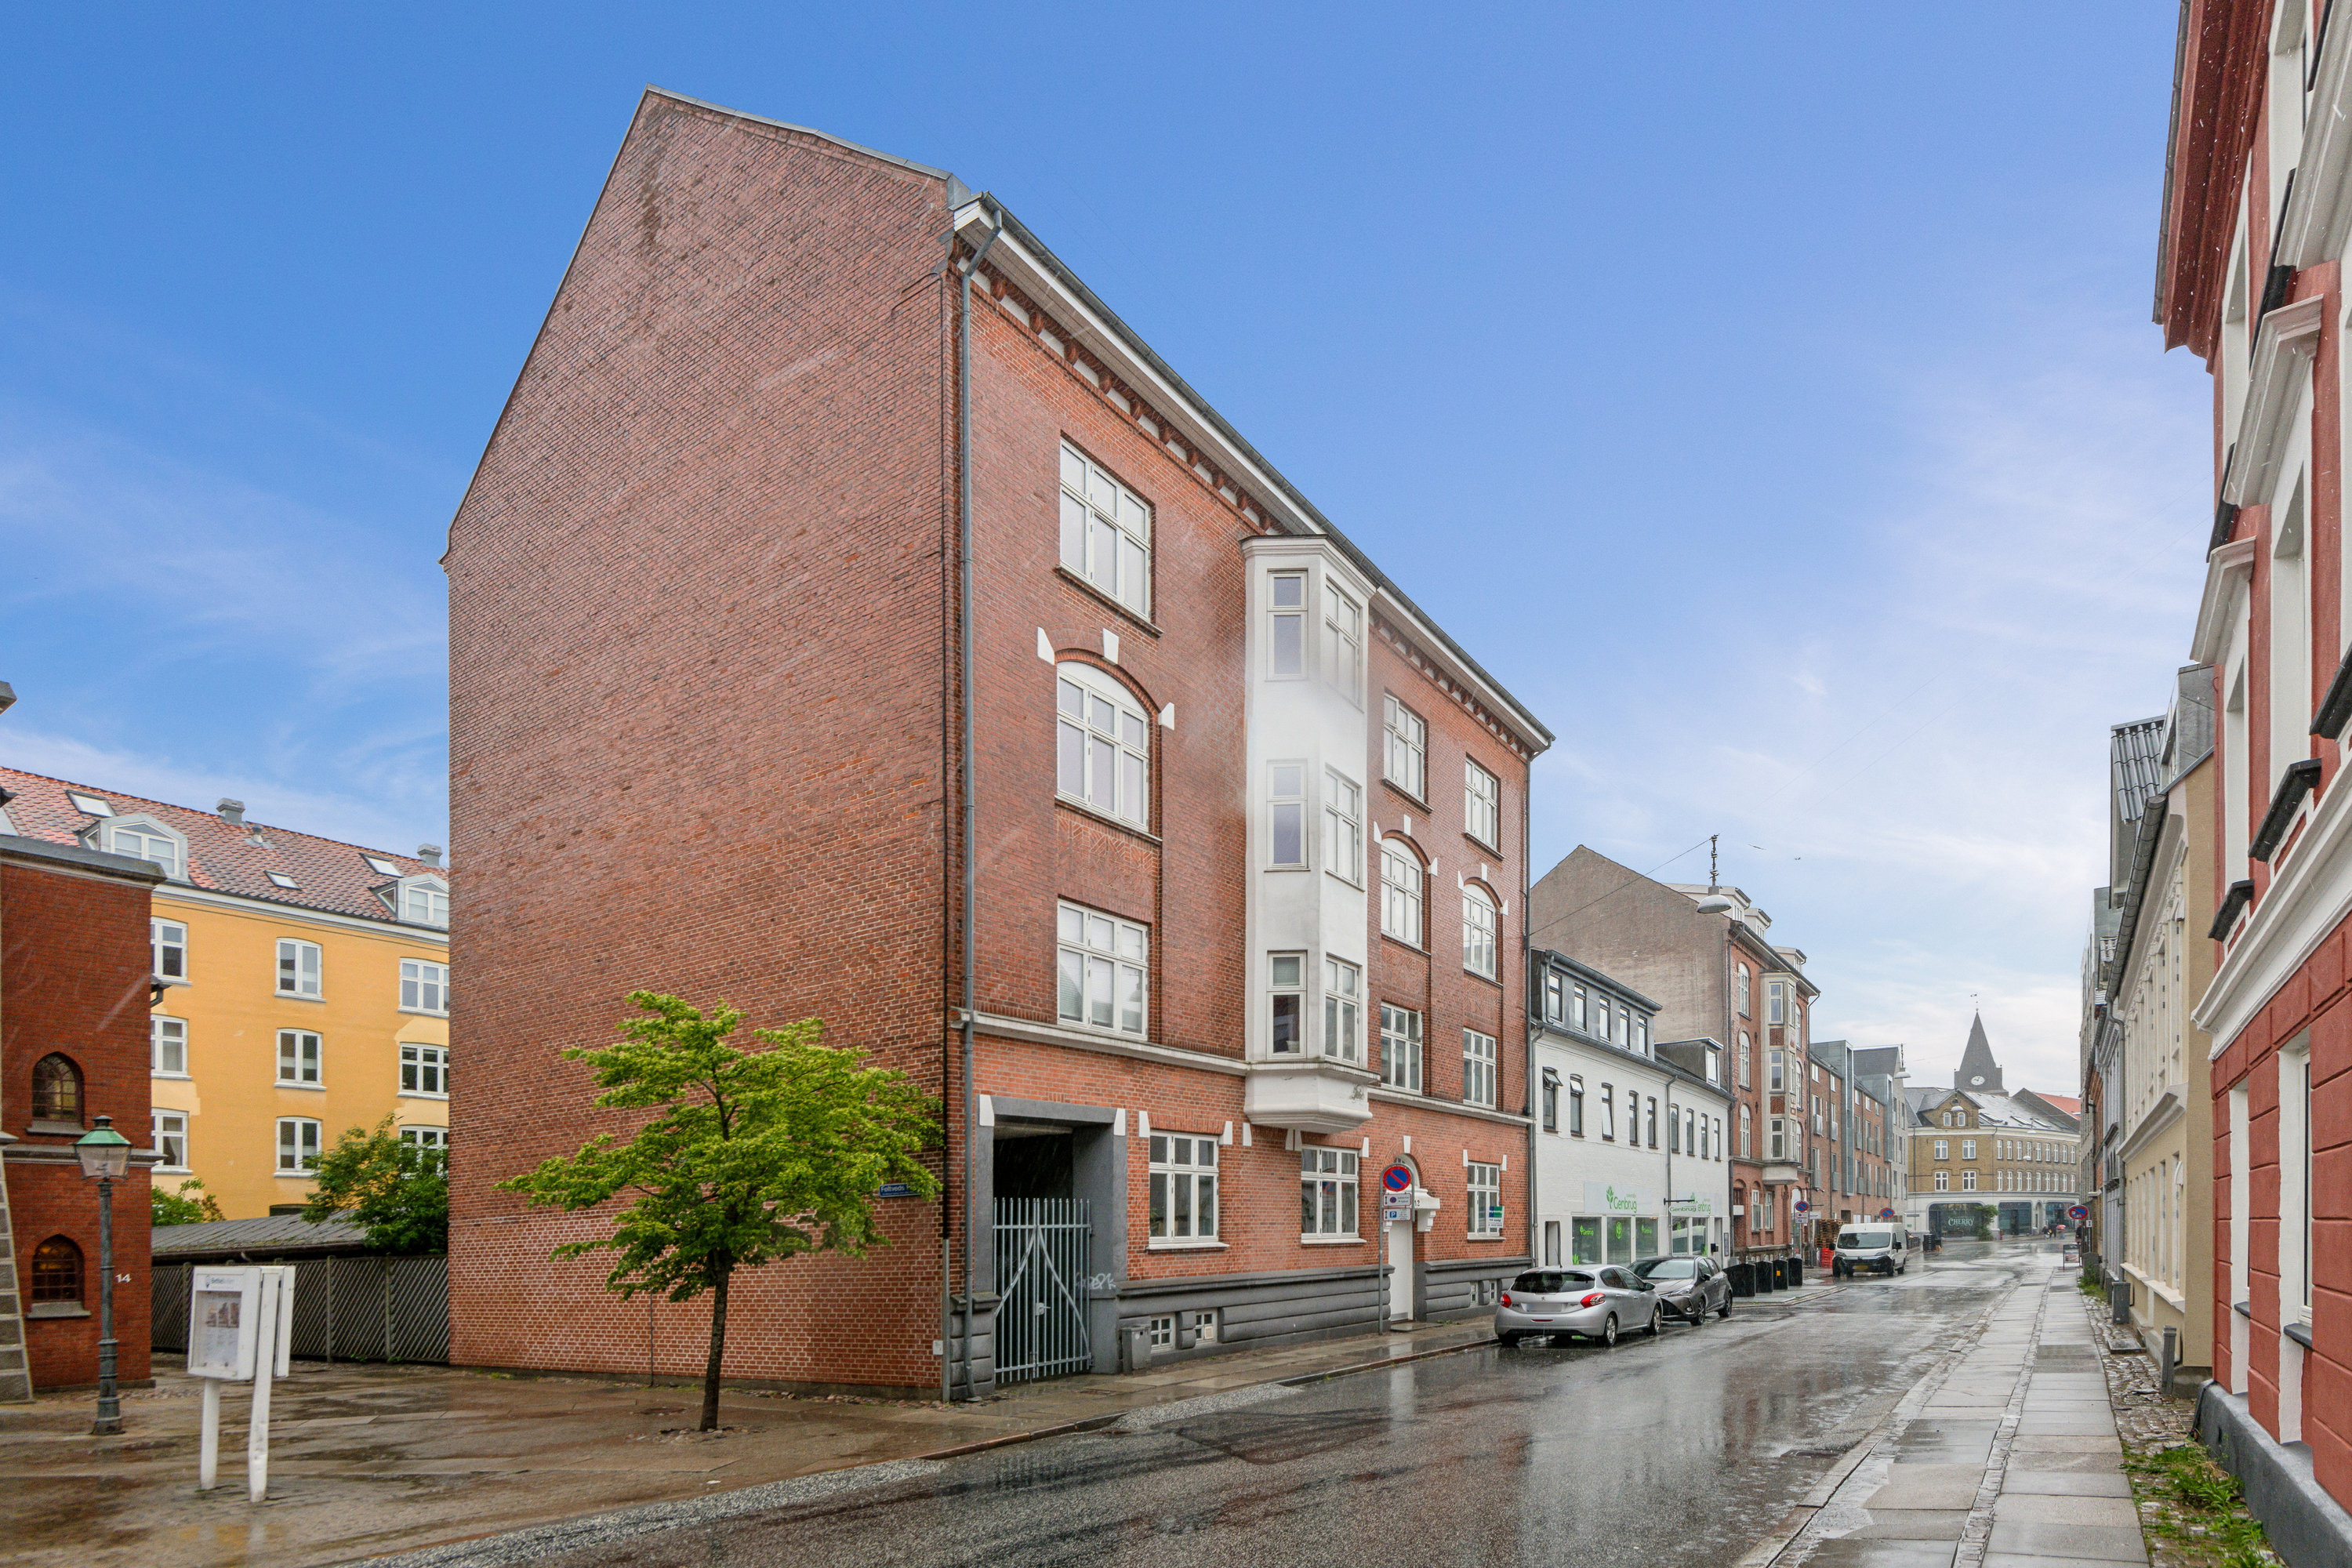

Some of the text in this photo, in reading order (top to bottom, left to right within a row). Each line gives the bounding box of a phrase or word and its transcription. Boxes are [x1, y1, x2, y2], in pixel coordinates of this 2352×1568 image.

[1613, 1196, 1638, 1214] Genbrug
[1948, 1217, 1975, 1226] CHERRY
[114, 1273, 132, 1283] 14
